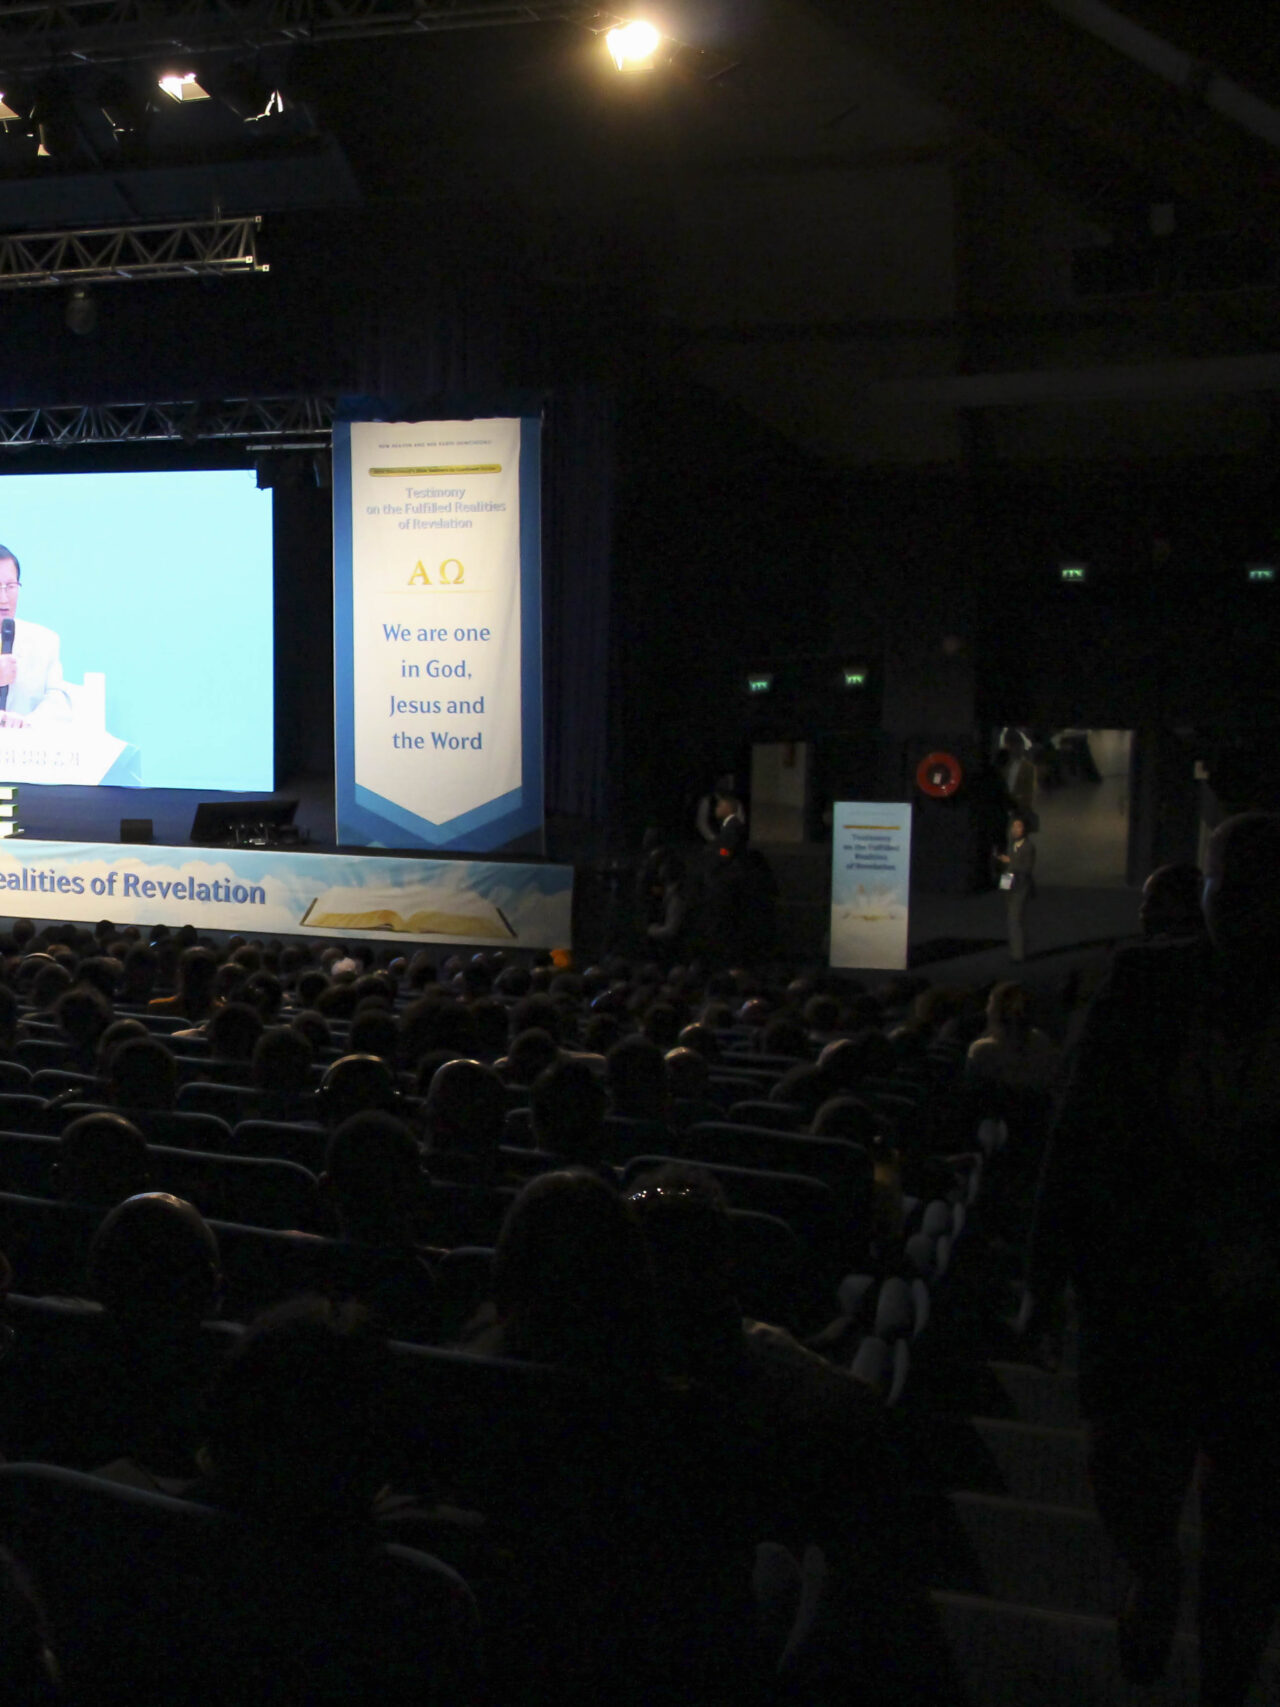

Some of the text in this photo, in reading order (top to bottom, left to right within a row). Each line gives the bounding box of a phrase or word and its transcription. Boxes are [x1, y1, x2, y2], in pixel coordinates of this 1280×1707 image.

[406, 487, 466, 500] Testimony
[366, 501, 506, 514] on the Fulfilled Realities
[398, 518, 472, 530] of Revelation
[382, 624, 490, 642] We are one
[402, 660, 472, 680] in God,
[390, 696, 484, 717] Jesus and
[392, 731, 482, 750] the Word
[90, 871, 118, 896] of
[123, 872, 266, 904] Revelation
